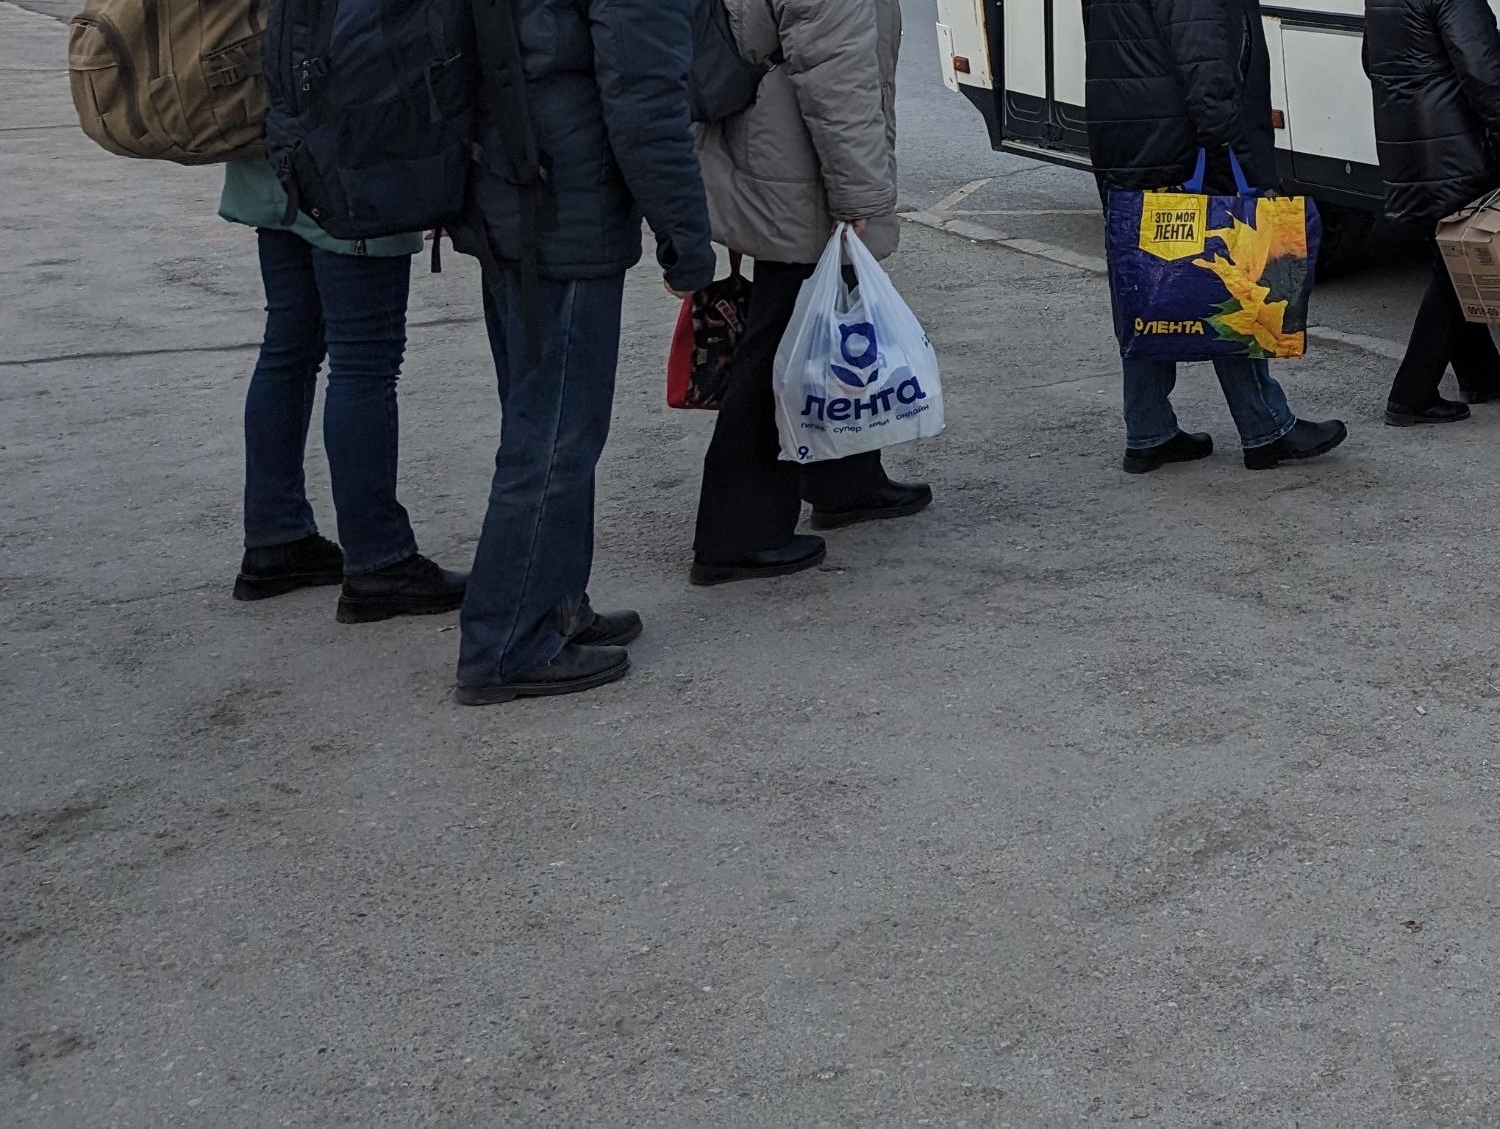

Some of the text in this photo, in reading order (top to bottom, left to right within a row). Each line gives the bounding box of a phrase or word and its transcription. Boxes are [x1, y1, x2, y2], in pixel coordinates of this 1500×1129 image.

[1155, 212, 1196, 223] ЭТО МОЯ
[1154, 224, 1195, 240] ЛЕНТА
[1143, 321, 1205, 335] ЛЕНТА
[801, 375, 926, 421] лента
[833, 425, 862, 433] супер
[896, 404, 930, 420] онлайн
[798, 446, 809, 460] 9
